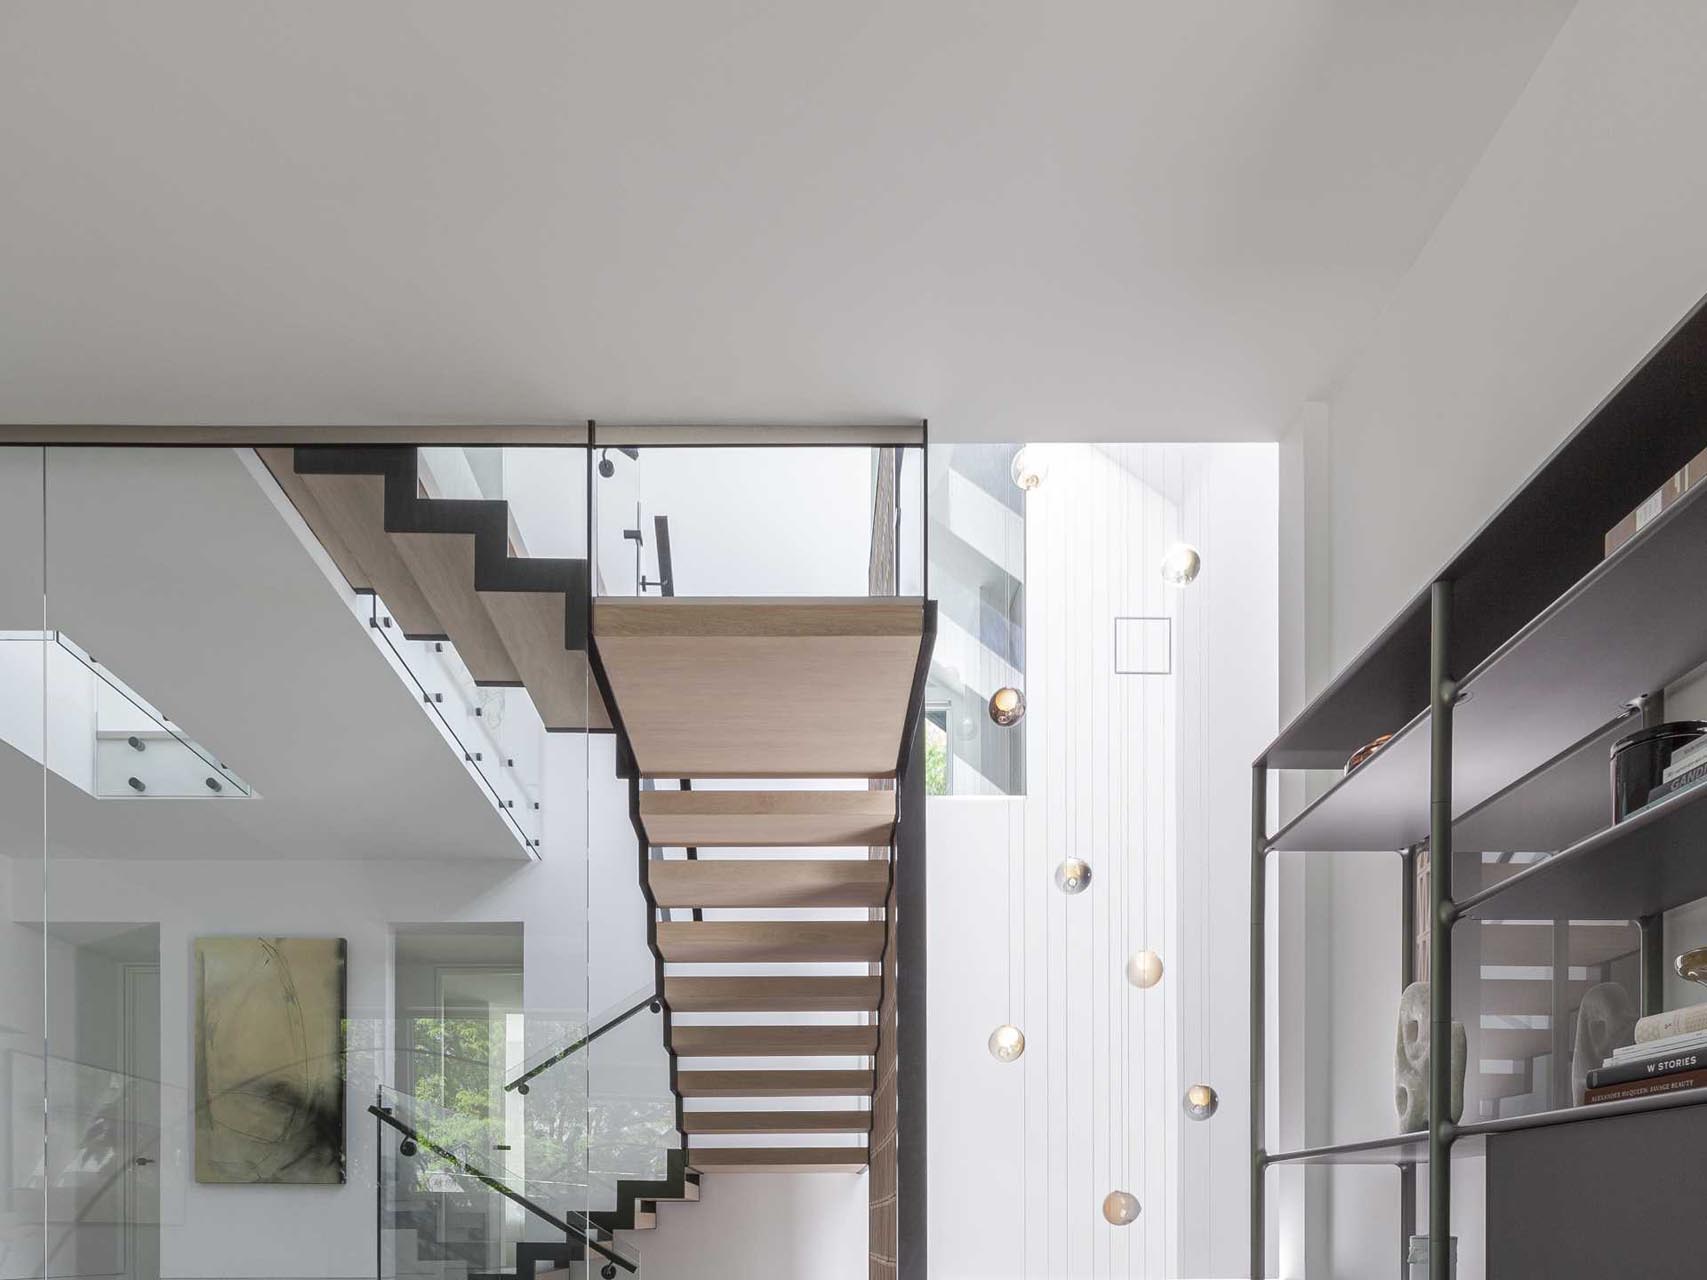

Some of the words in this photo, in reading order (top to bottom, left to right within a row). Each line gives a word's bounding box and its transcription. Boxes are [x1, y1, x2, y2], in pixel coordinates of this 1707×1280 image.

[1647, 1064, 1655, 1073] W
[1658, 1056, 1697, 1071] STORIES
[1671, 1079, 1694, 1089] BEAUTY
